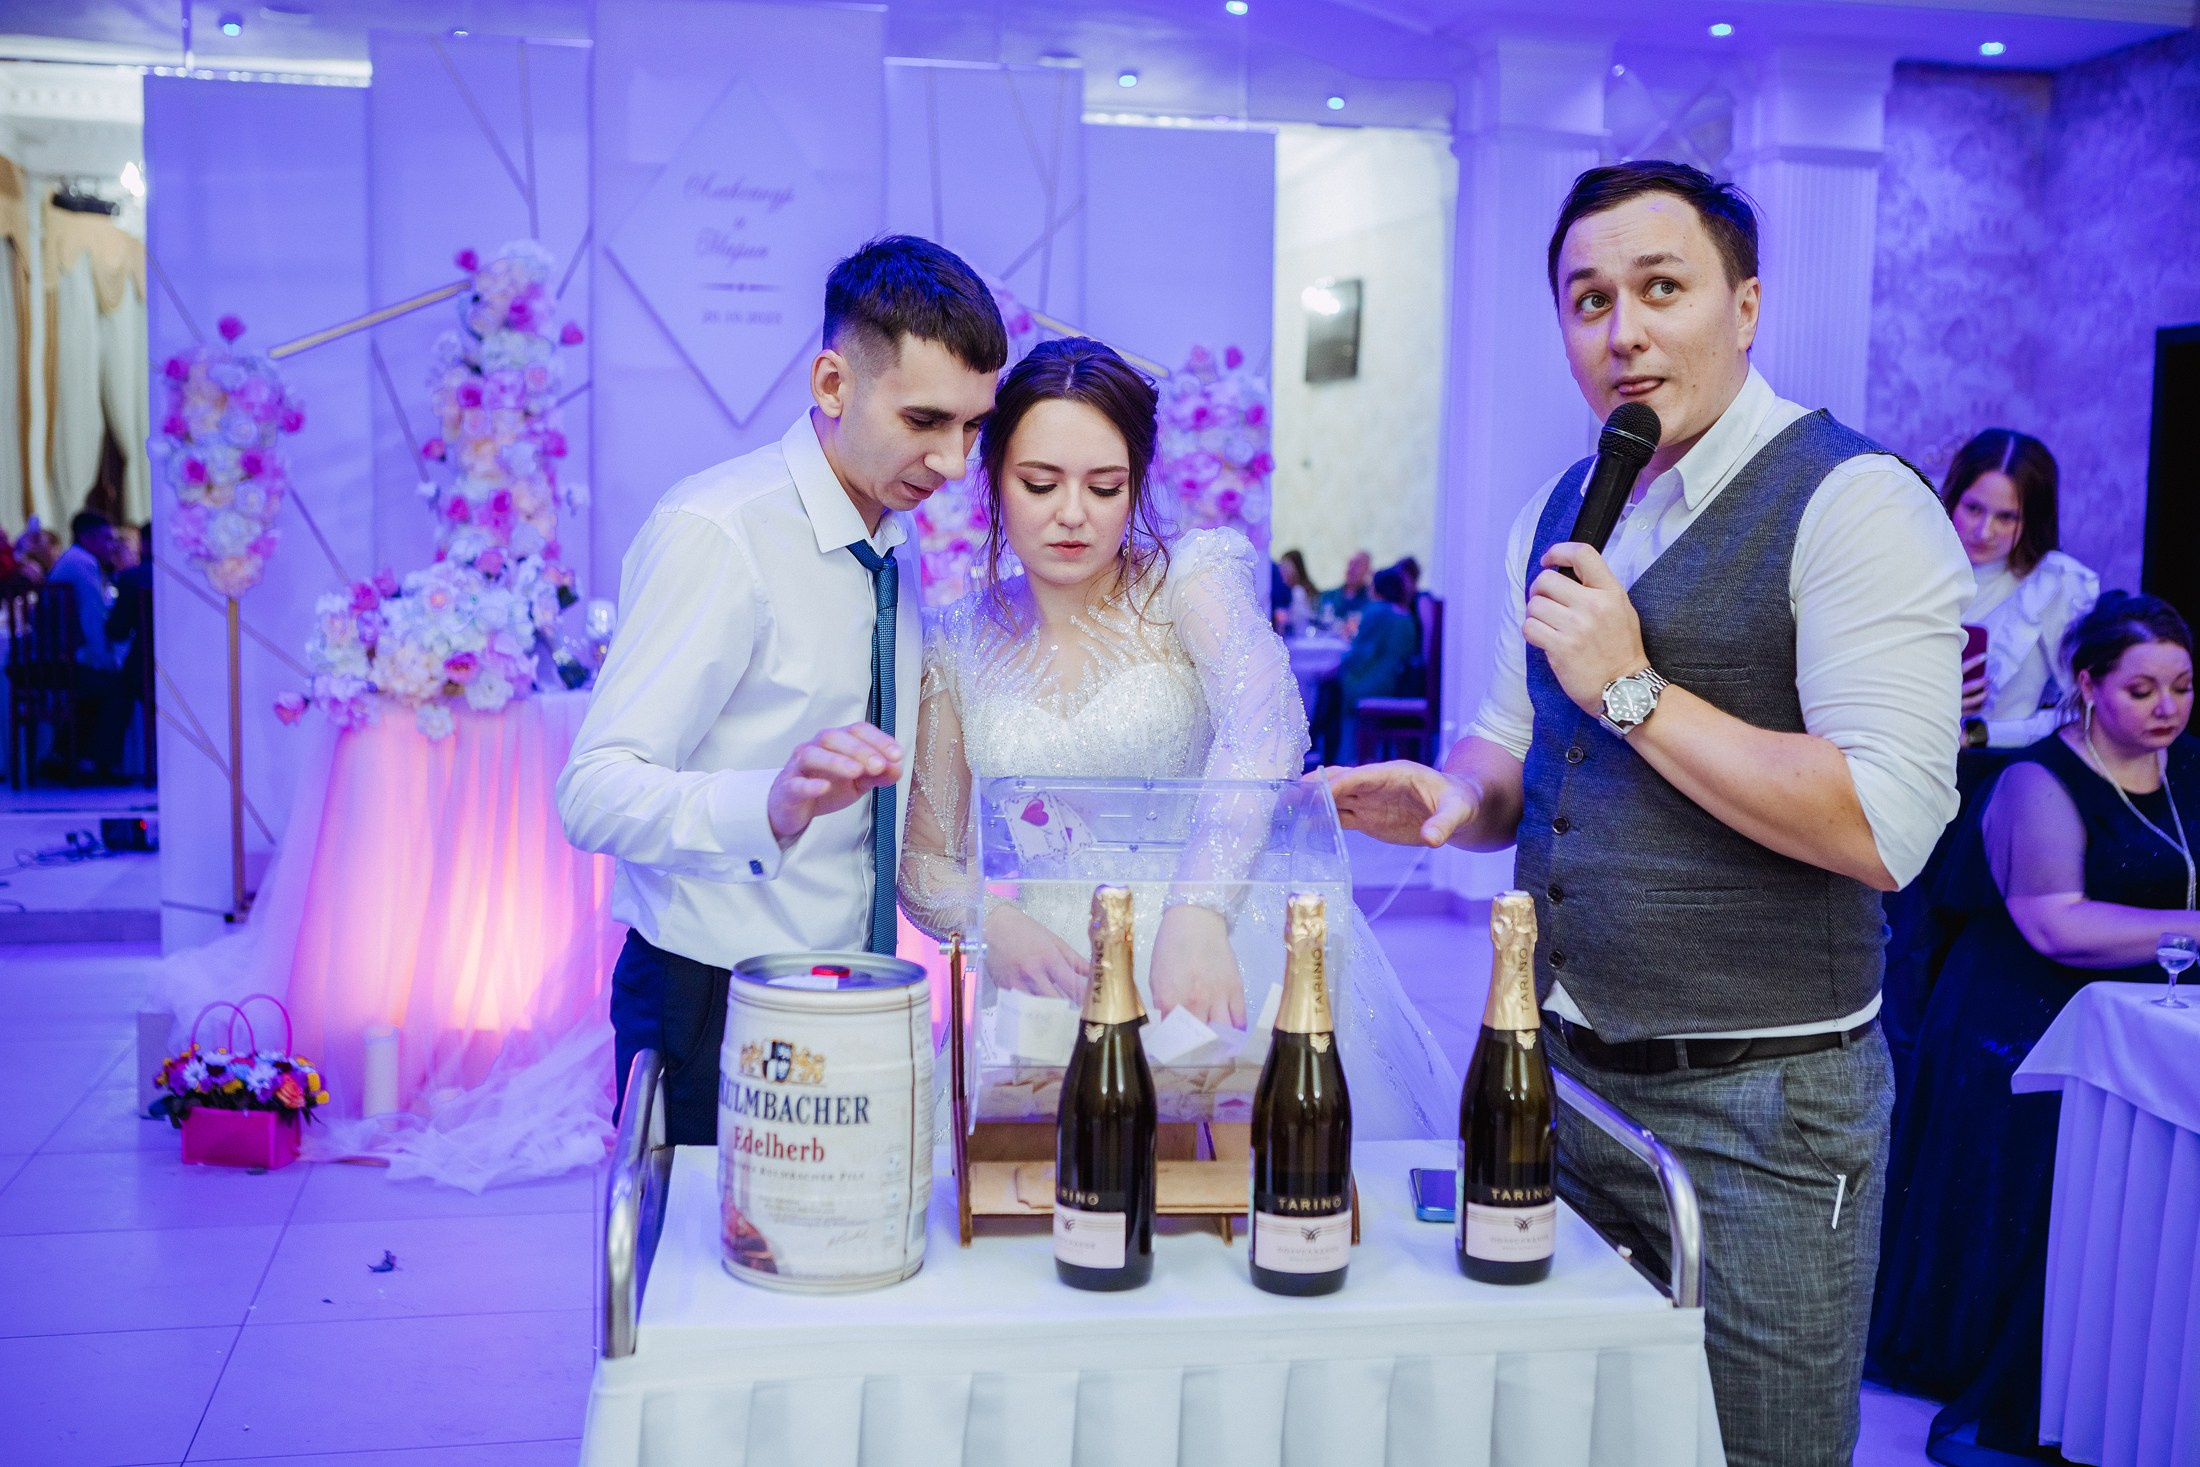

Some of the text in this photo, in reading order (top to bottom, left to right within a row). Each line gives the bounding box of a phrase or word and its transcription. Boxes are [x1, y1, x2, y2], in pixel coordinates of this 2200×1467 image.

[1092, 939, 1105, 1004] TARINO
[1312, 947, 1324, 1016] TARINO
[1519, 947, 1530, 1014] TARINO
[733, 1126, 827, 1164] Edelherb
[1057, 1186, 1100, 1206] RINO
[1277, 1194, 1342, 1212] TARINO
[1490, 1184, 1552, 1202] TARINO
